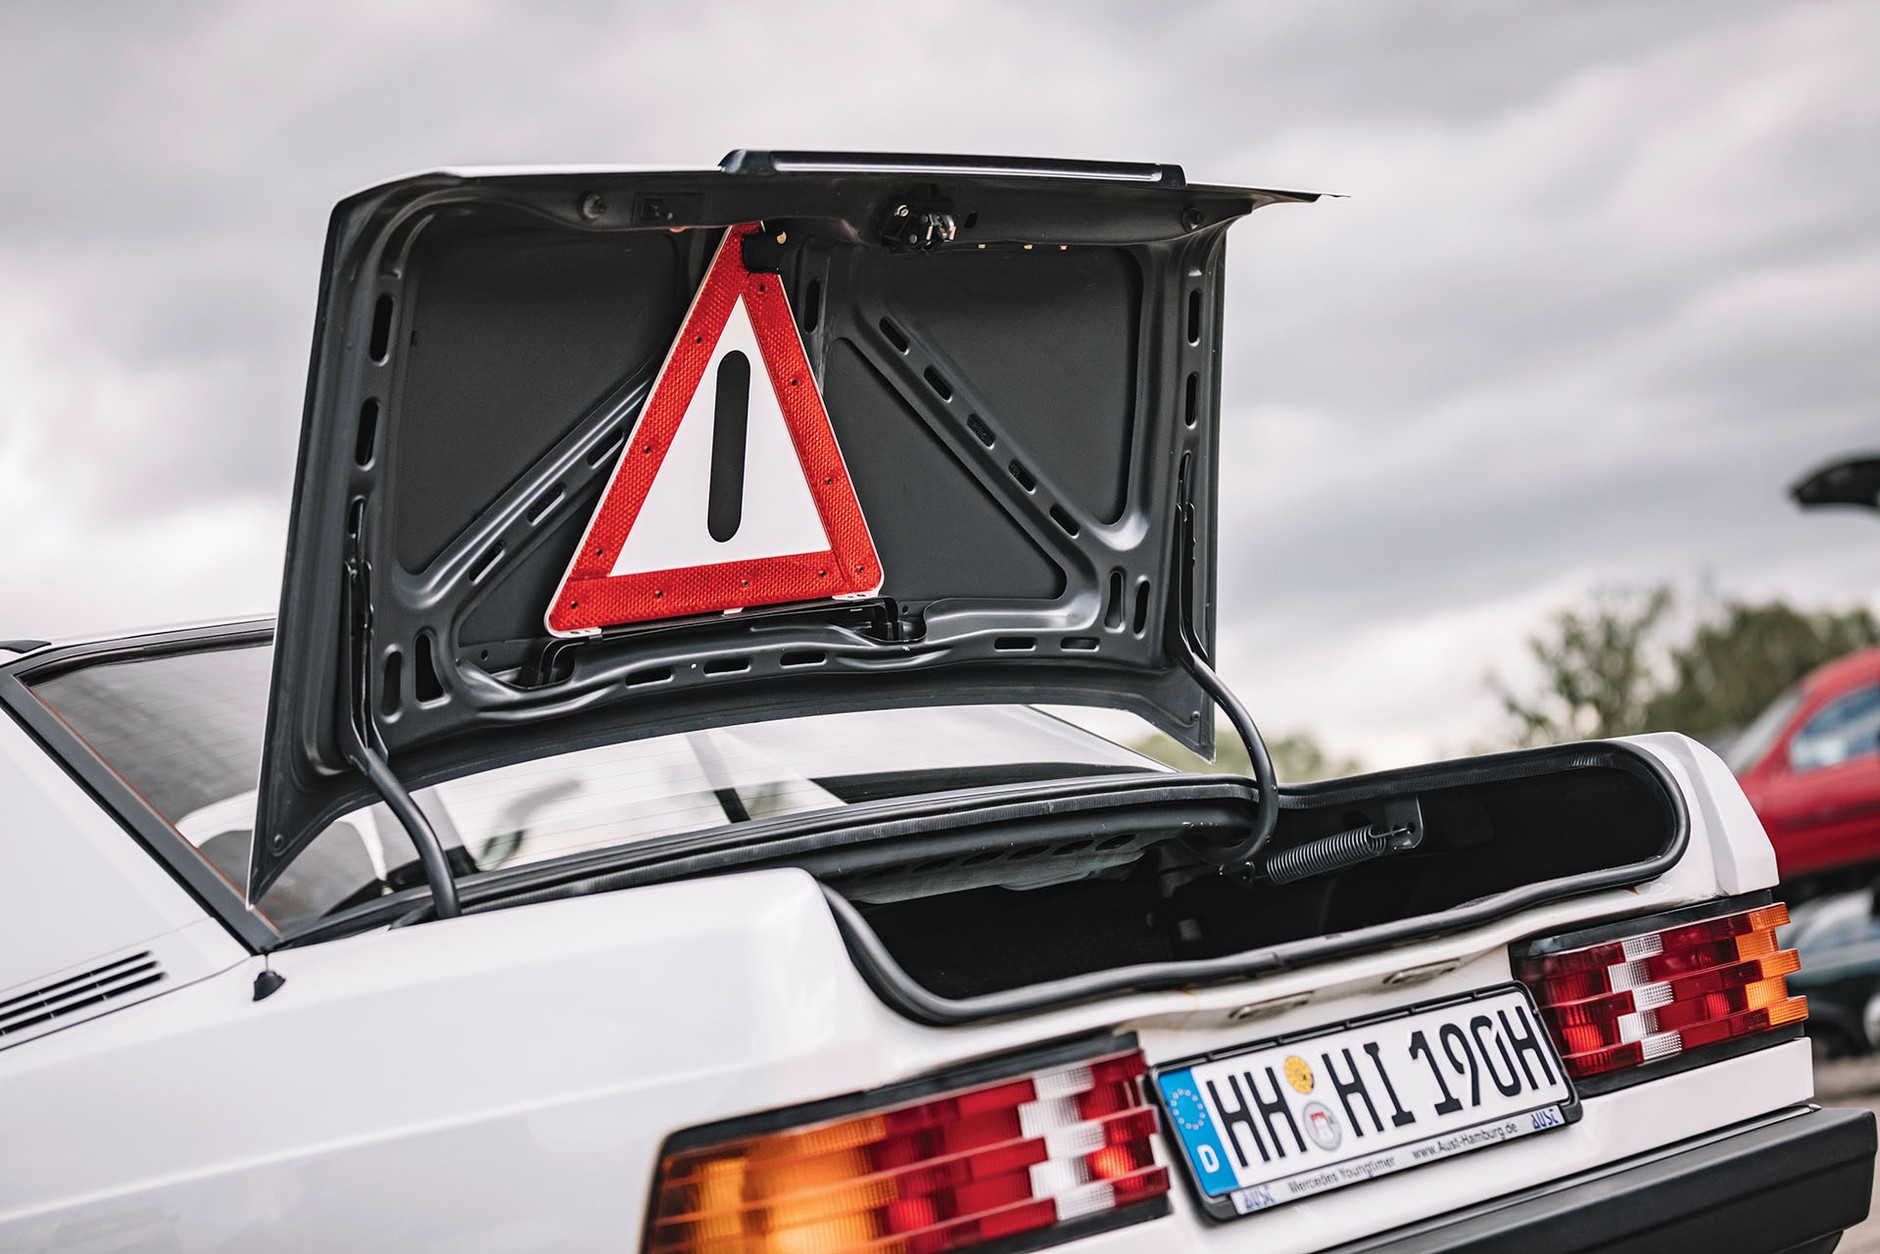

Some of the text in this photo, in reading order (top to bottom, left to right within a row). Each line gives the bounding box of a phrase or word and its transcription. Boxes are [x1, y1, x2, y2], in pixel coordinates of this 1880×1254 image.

[1206, 1006, 1557, 1167] HH HI 190H
[1197, 1144, 1219, 1173] D
[1412, 1122, 1518, 1160] www.Aust-Hamburg.de
[1288, 1156, 1396, 1194] Mercedes Youngtimer
